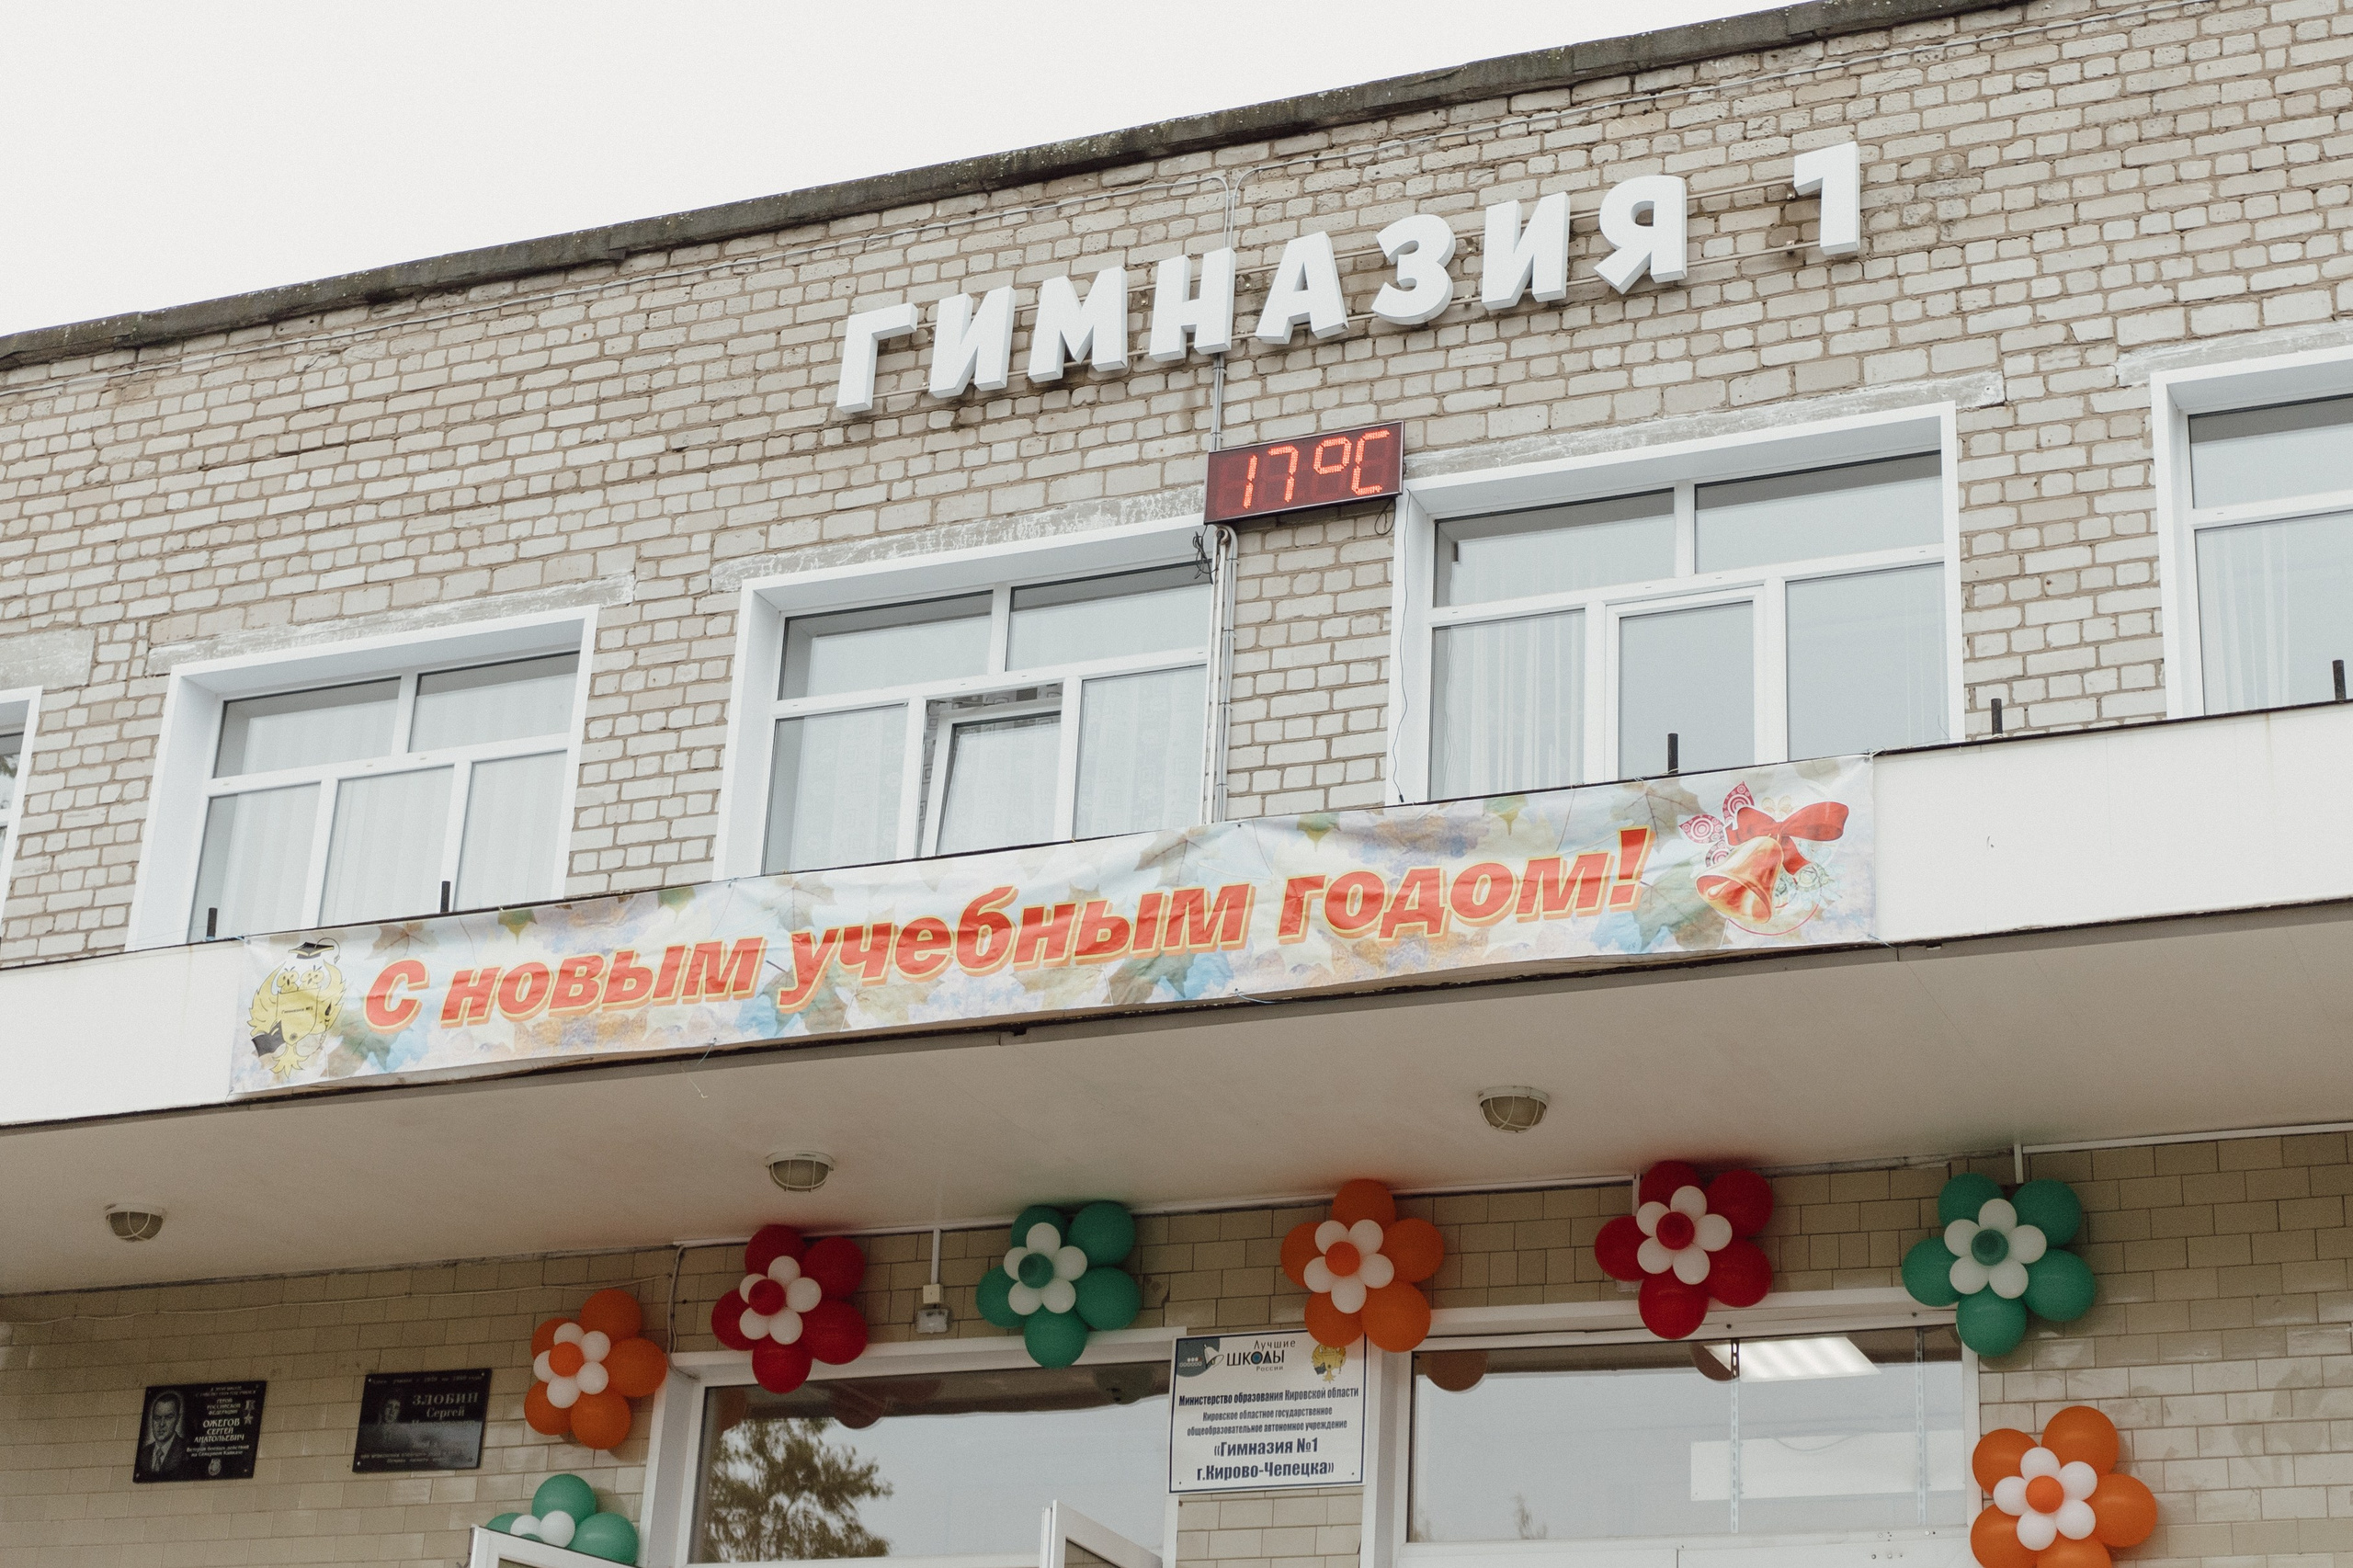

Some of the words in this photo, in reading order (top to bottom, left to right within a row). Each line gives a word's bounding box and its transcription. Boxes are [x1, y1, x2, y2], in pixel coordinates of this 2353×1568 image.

[835, 175, 1688, 415] ГИМНАЗИЯ
[1793, 141, 1861, 256] 1
[362, 960, 431, 1035] С
[439, 936, 769, 1029] новым
[777, 885, 1256, 1014] учебным
[1276, 825, 1655, 946] годом!
[1254, 1339, 1296, 1352] Лучшие
[1227, 1350, 1285, 1367] ШКОЛЫ
[412, 1392, 479, 1405] ЗЛОБИН
[1179, 1394, 1233, 1406] Министерство
[1234, 1391, 1283, 1404] образования
[1285, 1387, 1325, 1401] Кировской
[1327, 1387, 1358, 1398] области
[426, 1405, 466, 1420] Сергей
[1202, 1411, 1237, 1422] Кировское
[1239, 1408, 1274, 1419] областное
[1276, 1406, 1332, 1419] государственное
[202, 1418, 240, 1428] ОЖЕГОВ
[206, 1427, 234, 1436] СЕРГЕЙ
[1187, 1424, 1263, 1437] общеобразовательное
[1264, 1422, 1304, 1433] автономное
[1305, 1419, 1347, 1431] учреждение
[1214, 1440, 1292, 1457] «Гимназия
[1297, 1437, 1318, 1454] №1
[1197, 1461, 1335, 1481] г.Кирово-Чепецка»
